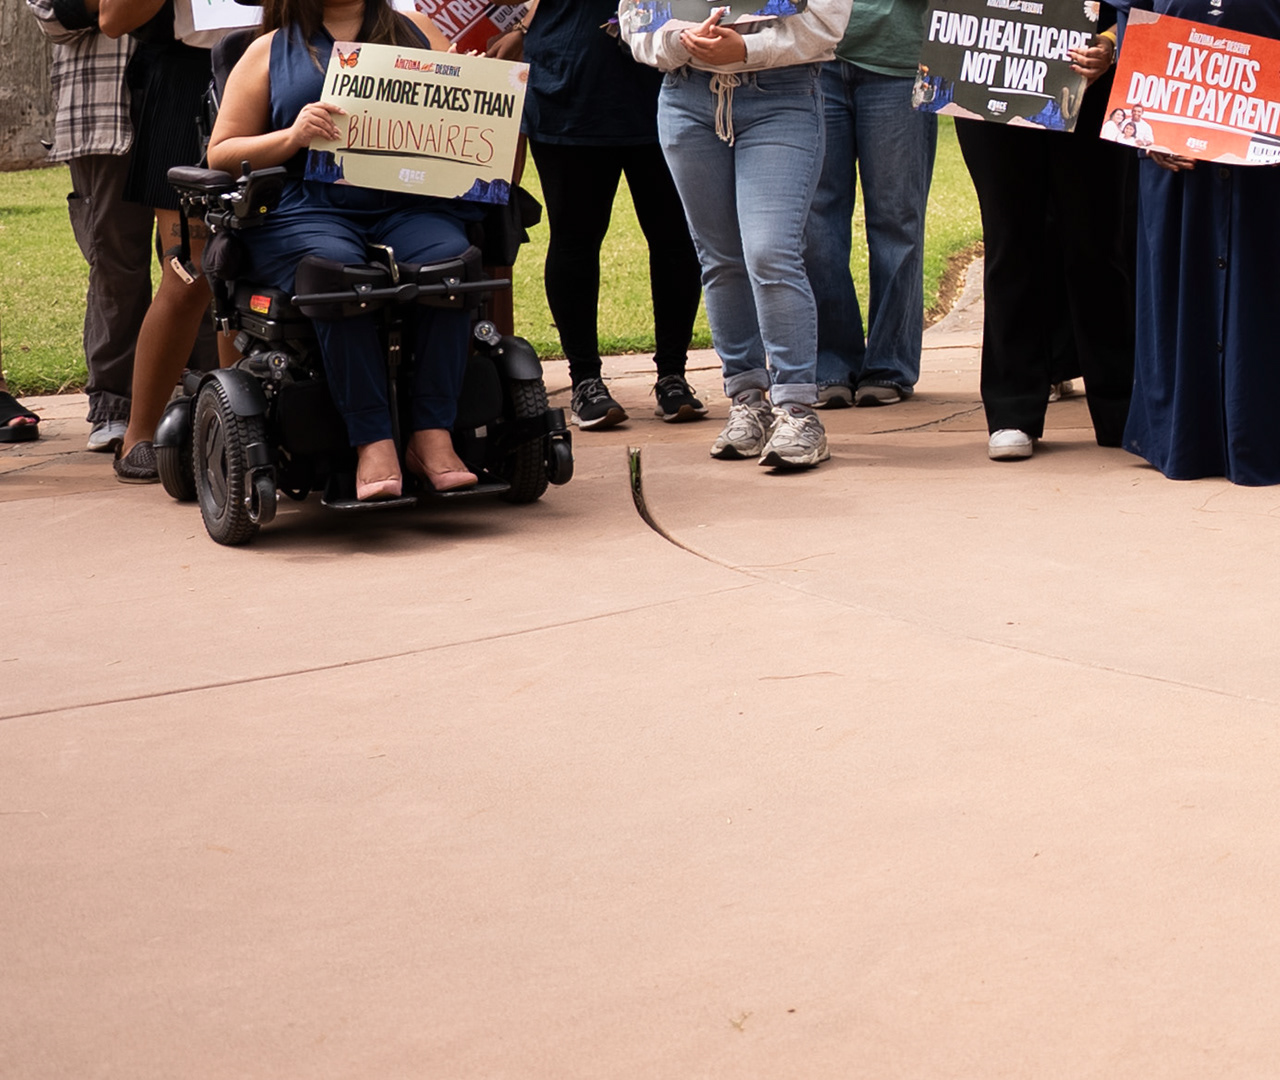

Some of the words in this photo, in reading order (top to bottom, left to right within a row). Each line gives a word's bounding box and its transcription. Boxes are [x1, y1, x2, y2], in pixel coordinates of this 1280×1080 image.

[928, 9, 979, 47] FUND
[960, 50, 1002, 86] NOT
[1003, 56, 1048, 93] WAR
[1165, 41, 1210, 83] TAX
[1205, 51, 1261, 94] CUTS
[331, 73, 339, 96] I
[338, 74, 375, 99] PAID
[375, 77, 422, 106] MORE
[423, 83, 472, 113] TAXES
[472, 89, 516, 119] THAN
[1126, 71, 1191, 115] DON'T
[1186, 85, 1233, 122] PAY
